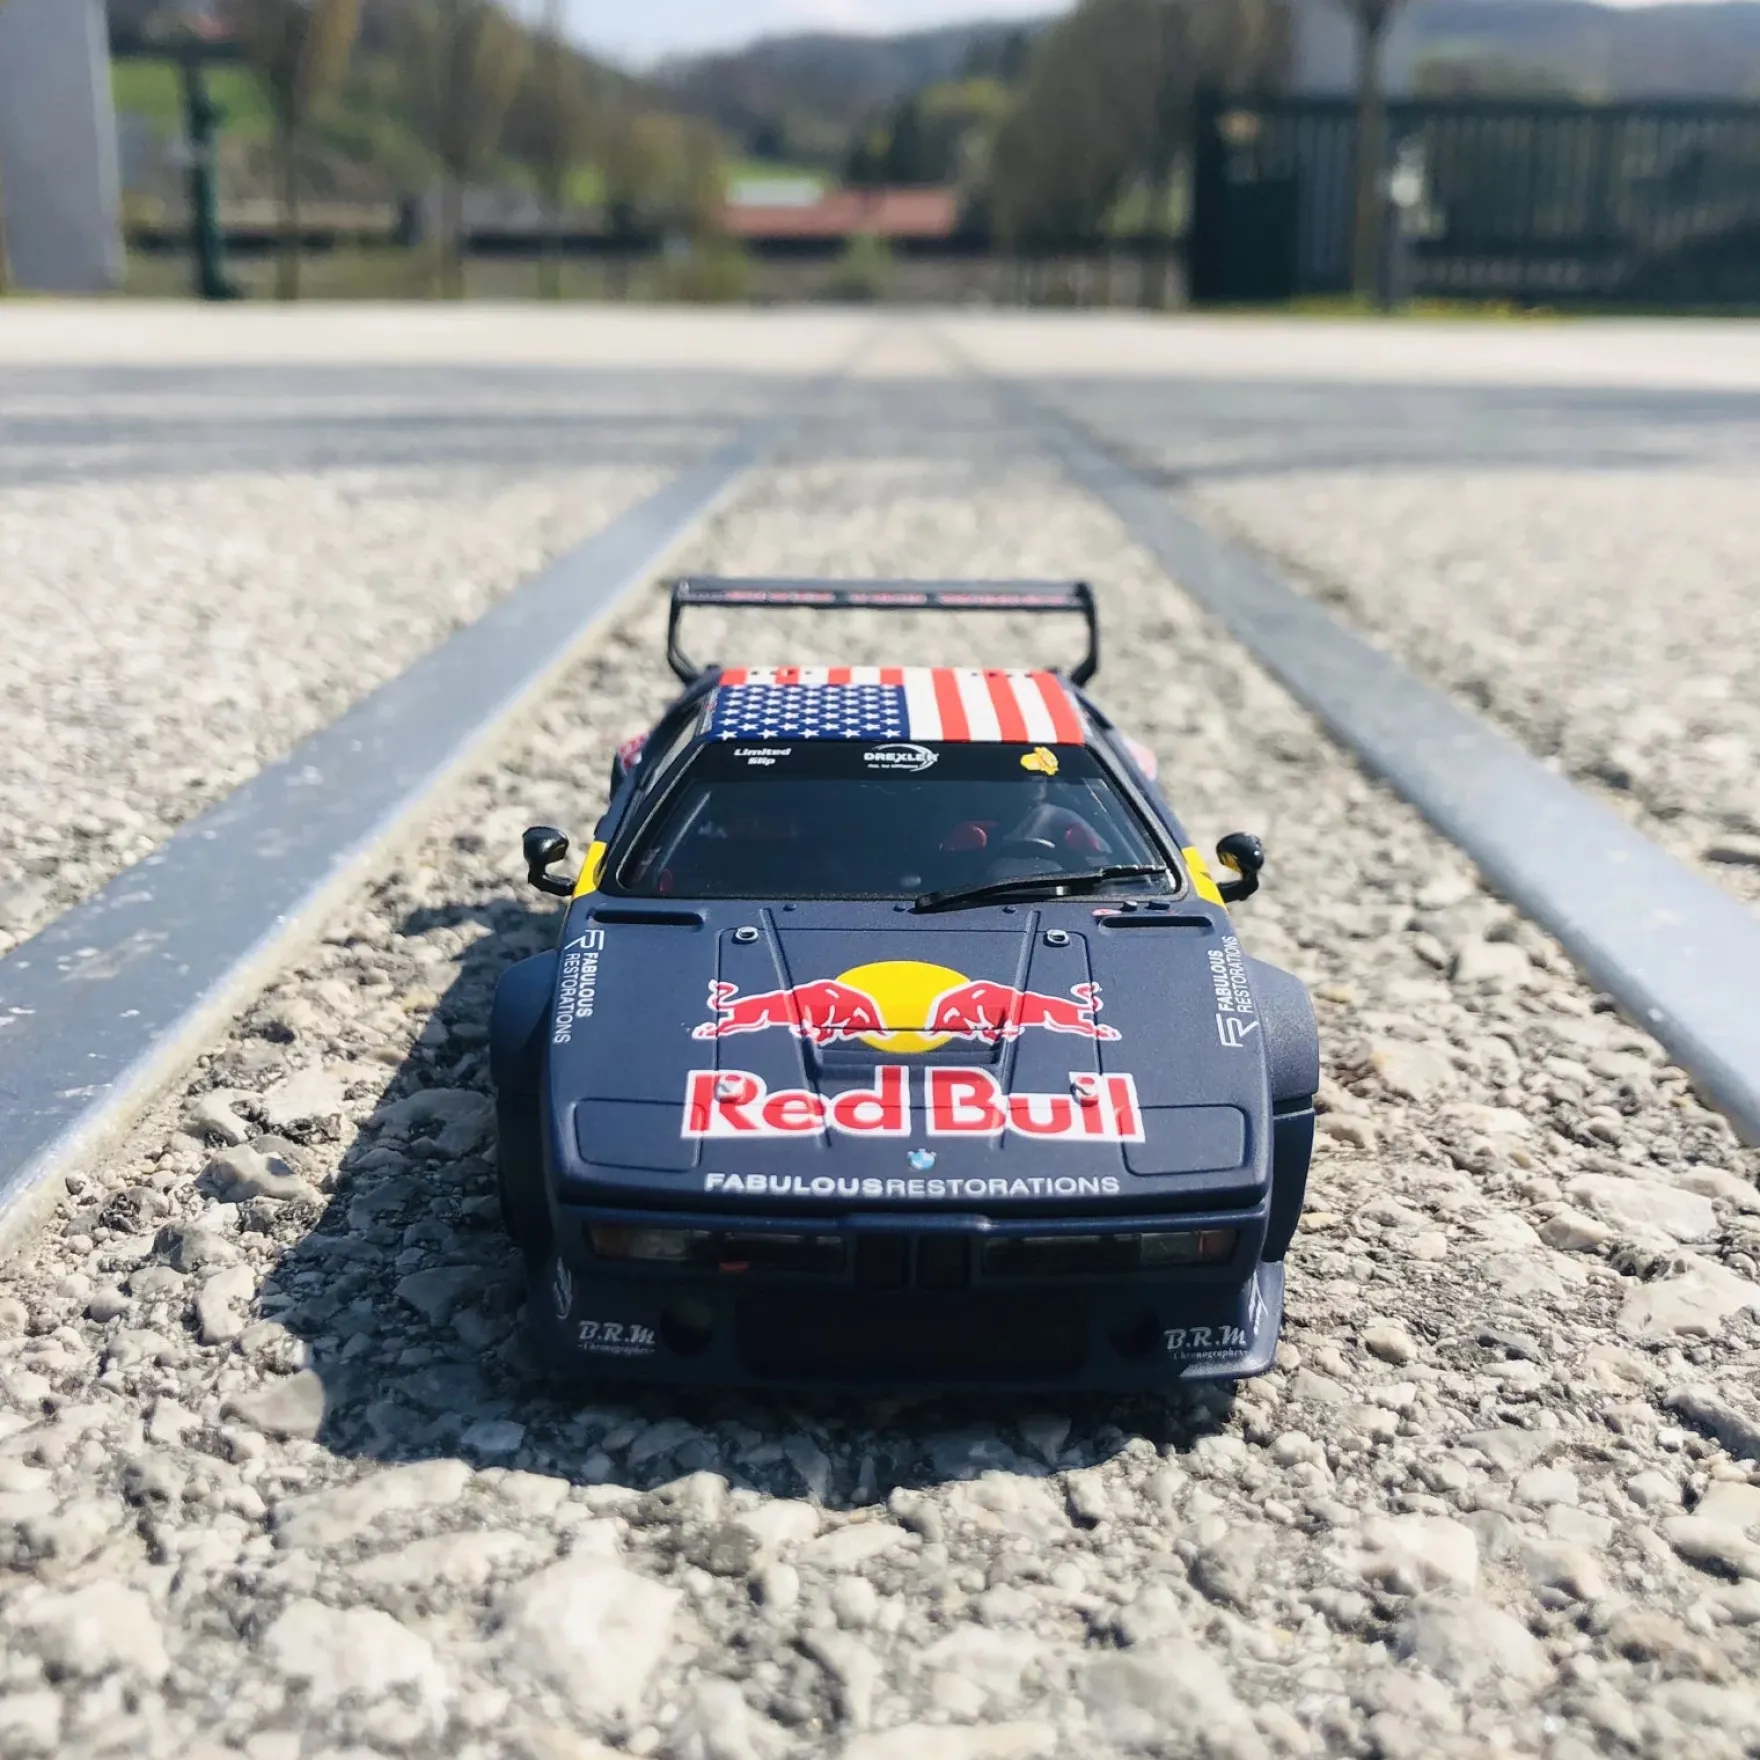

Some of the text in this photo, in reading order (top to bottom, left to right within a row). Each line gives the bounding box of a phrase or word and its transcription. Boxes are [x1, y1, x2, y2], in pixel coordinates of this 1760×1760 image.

[734, 748, 792, 756] Limited
[748, 756, 776, 766] Slip
[863, 752, 940, 763] DREXLER
[553, 952, 581, 1044] RESTORATIONS
[576, 952, 599, 1018] FABULOUS
[1208, 949, 1236, 1012] FABULOUS
[1221, 936, 1254, 1013] RESTORATIONS
[684, 1065, 1141, 1140] Red Bull
